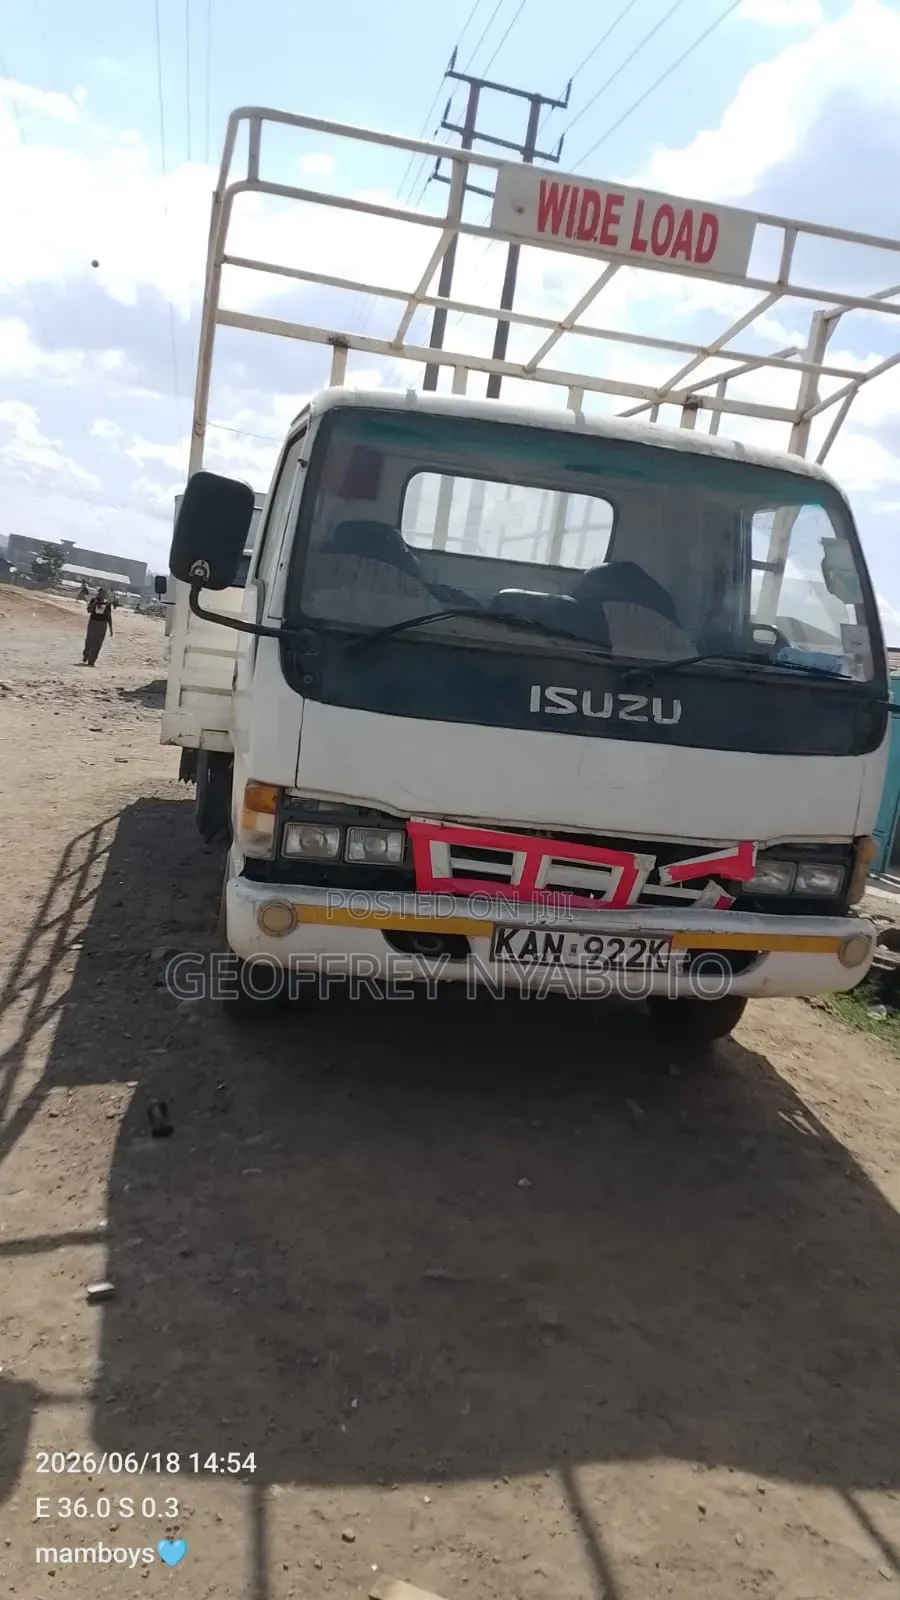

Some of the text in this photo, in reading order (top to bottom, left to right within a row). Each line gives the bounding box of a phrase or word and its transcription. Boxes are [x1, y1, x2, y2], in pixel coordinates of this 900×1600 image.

[537, 179, 719, 264] WIDE LOAD
[529, 685, 682, 724] ISUZU
[495, 928, 667, 969] KAN 922K
